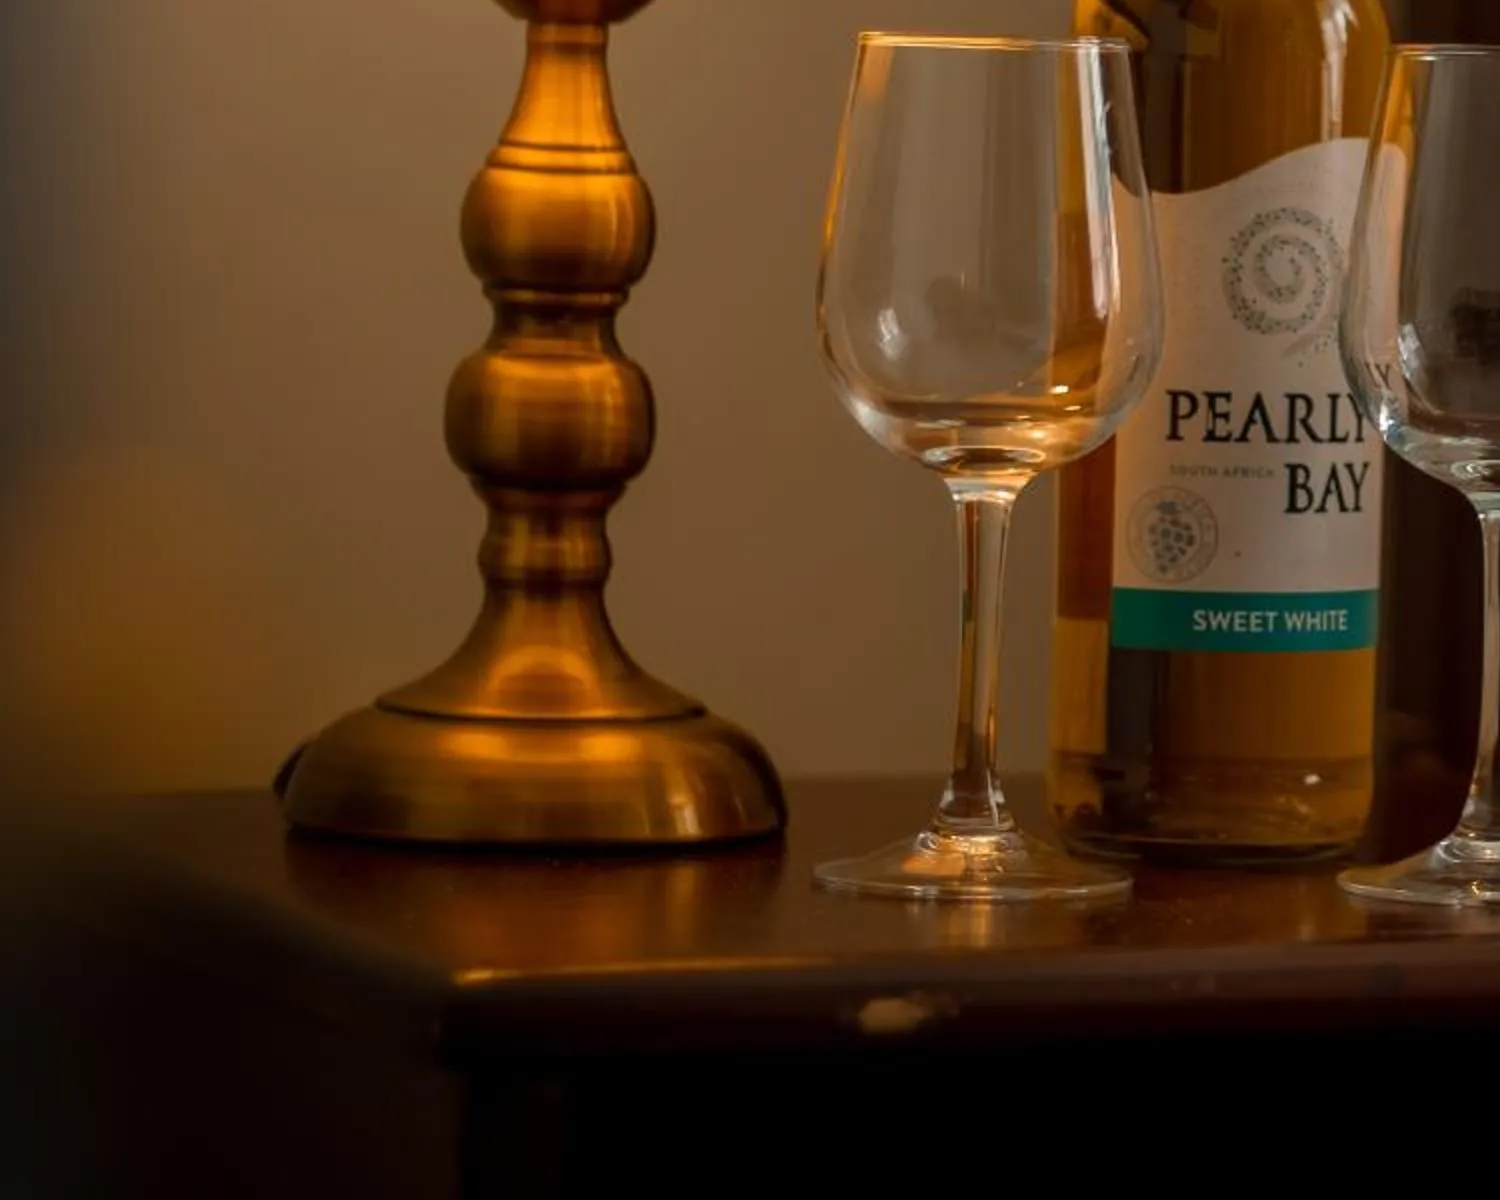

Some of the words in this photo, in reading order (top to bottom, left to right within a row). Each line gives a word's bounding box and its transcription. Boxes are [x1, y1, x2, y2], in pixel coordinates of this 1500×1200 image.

[1165, 388, 1366, 444] PEARLY
[1283, 460, 1370, 514] BAY
[1192, 609, 1279, 633] SWEET
[1284, 609, 1349, 632] WHITE
